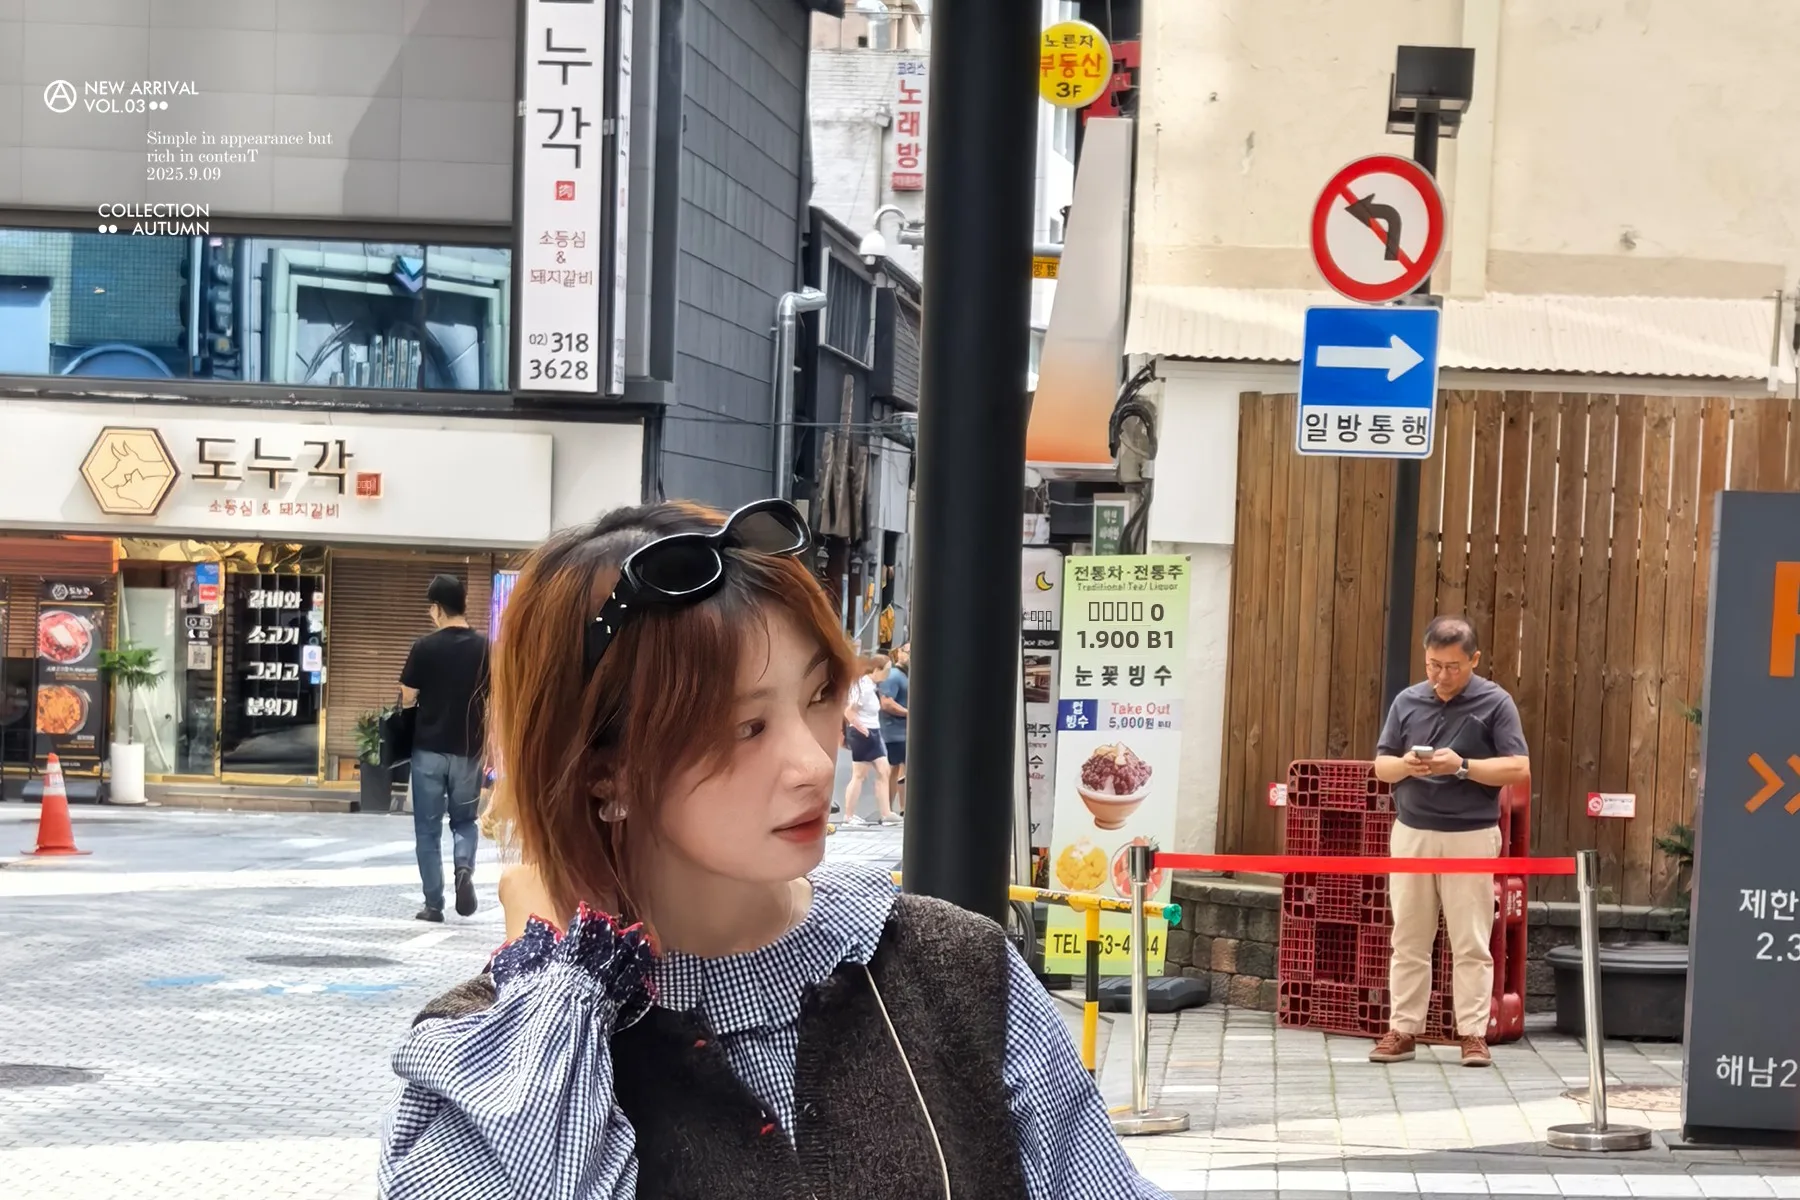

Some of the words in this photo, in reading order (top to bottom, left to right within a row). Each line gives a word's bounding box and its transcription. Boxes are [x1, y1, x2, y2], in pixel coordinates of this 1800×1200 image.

[1045, 34, 1094, 48] 노른자
[1040, 53, 1103, 79] 부동산
[536, 0, 593, 169] 누각
[1056, 82, 1082, 99] 3F
[896, 79, 923, 169] 노래방
[539, 231, 586, 249] 소등심
[530, 269, 594, 288] 돼지갈비
[551, 332, 589, 353] 318
[529, 359, 589, 380] 3628
[1305, 413, 1427, 446] 일방통행
[192, 437, 354, 495] 도누각
[249, 590, 303, 610] 갈비와
[247, 625, 299, 645] 소고기
[1148, 631, 1173, 649] B1
[246, 661, 299, 681] 그리고
[246, 697, 298, 717] 분위기
[1111, 702, 1142, 715] Take
[1146, 702, 1170, 715] Out
[1109, 717, 1154, 730] 5,000원
[1739, 889, 1799, 920] 제한
[1053, 934, 1081, 954] TEL
